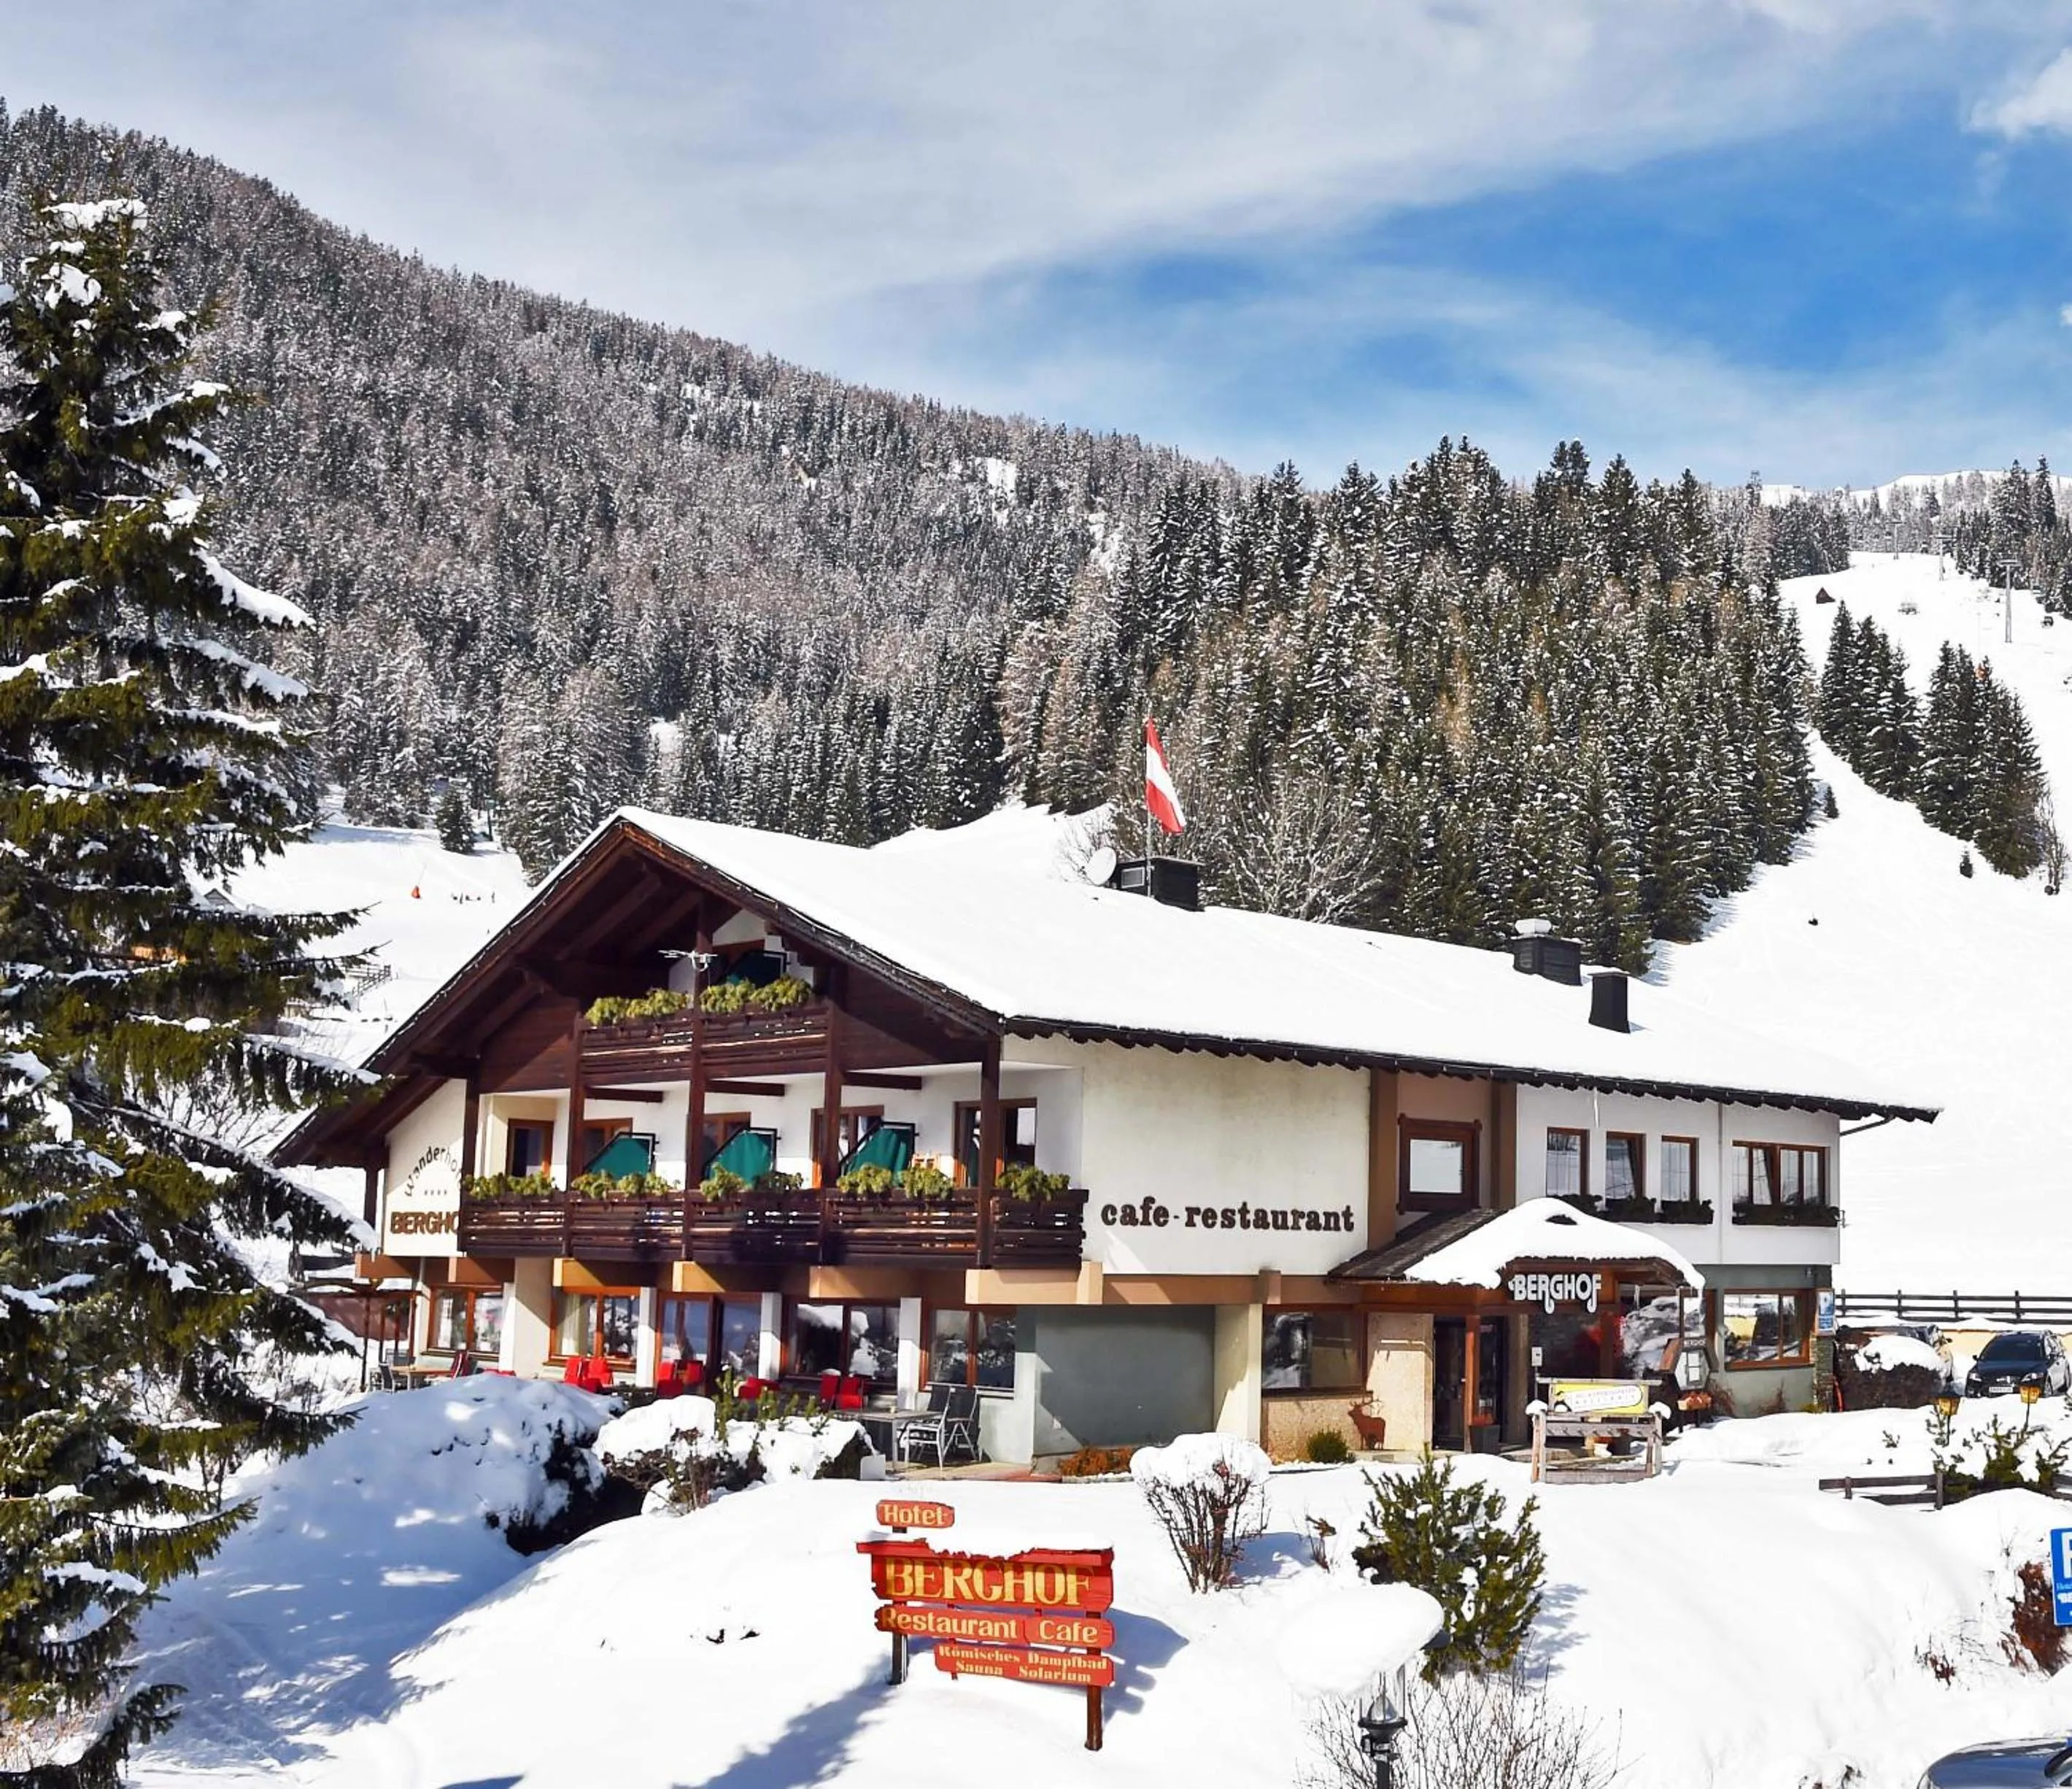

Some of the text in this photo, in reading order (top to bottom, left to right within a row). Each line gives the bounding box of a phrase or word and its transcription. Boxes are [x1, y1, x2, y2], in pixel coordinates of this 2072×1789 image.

[390, 1211, 460, 1234] BERGHO
[1508, 1273, 1601, 1314] BERGHOF
[883, 1504, 946, 1526] Hotel
[885, 1557, 1094, 1605] BERGHOF
[882, 1608, 1098, 1643] Restaurant Cafe
[955, 1660, 1091, 1682] Sauna Solarium
[1027, 1652, 1107, 1670] Dampfbad
